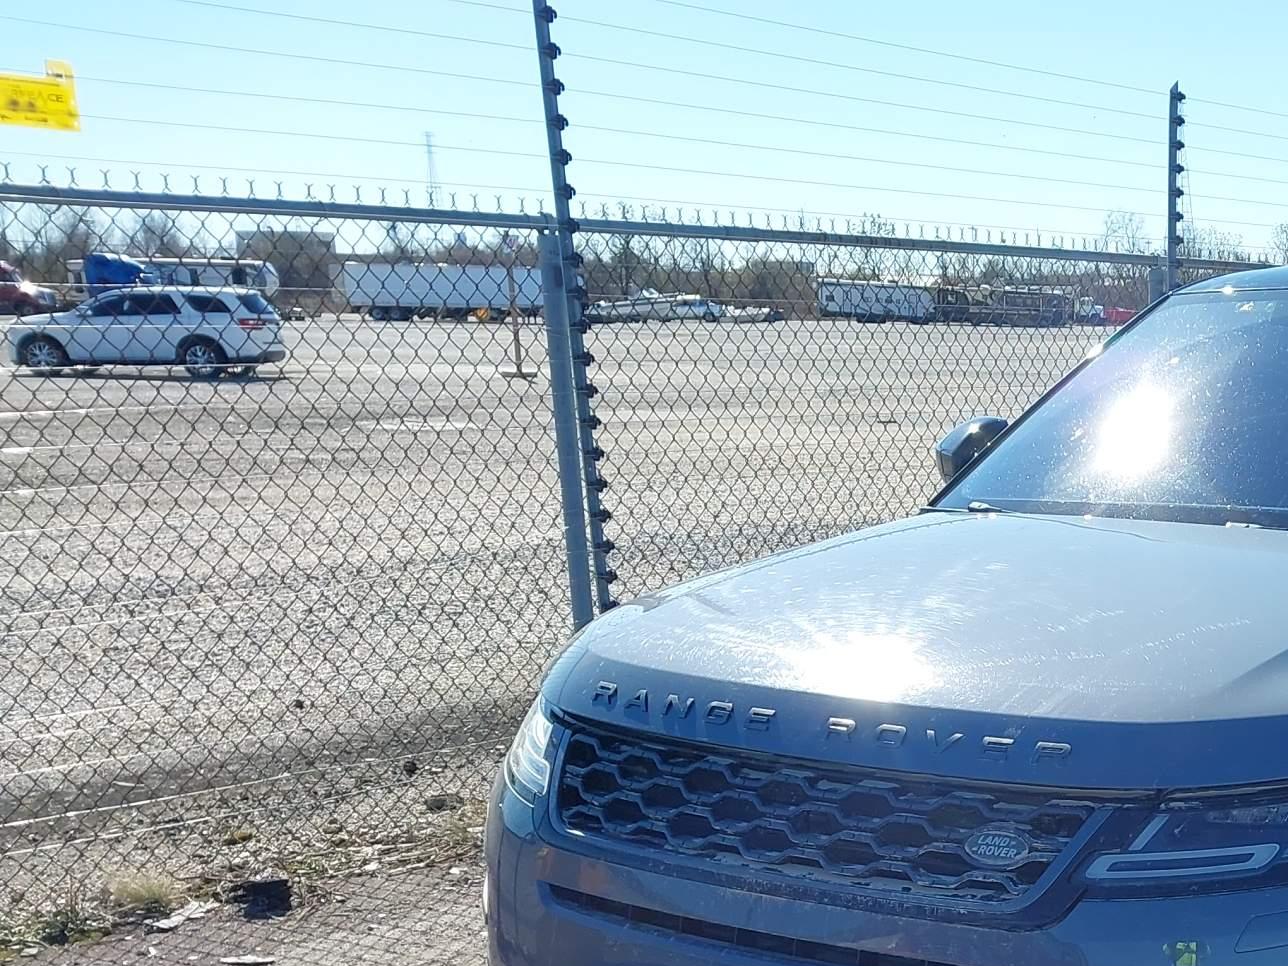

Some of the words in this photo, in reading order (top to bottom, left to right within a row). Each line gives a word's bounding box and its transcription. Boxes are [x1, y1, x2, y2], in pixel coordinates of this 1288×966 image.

[592, 680, 777, 732] RANGE
[826, 716, 1073, 767] ROVER
[978, 835, 1010, 847] LAND
[978, 844, 1017, 859] ROVER
